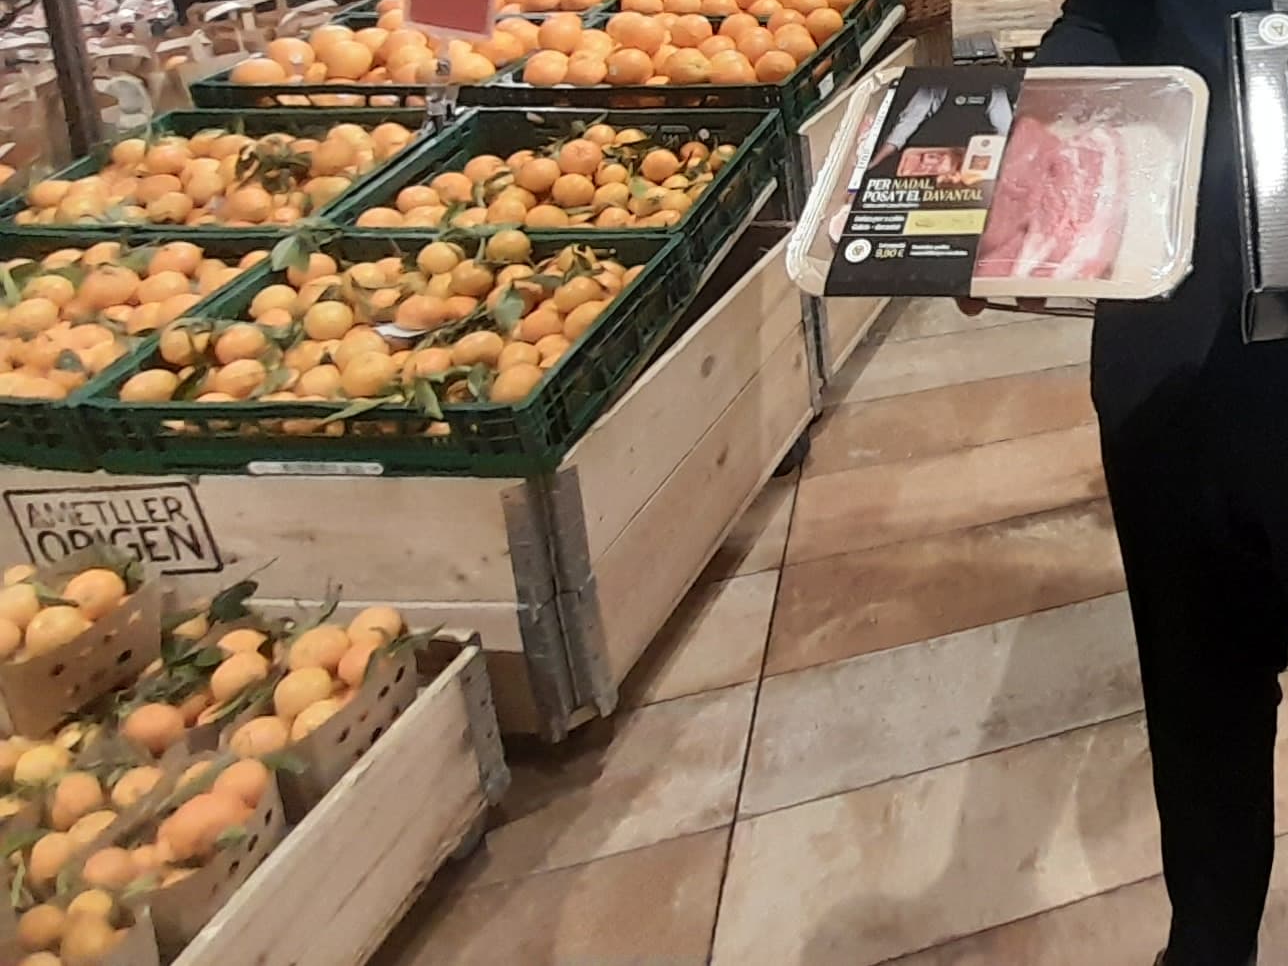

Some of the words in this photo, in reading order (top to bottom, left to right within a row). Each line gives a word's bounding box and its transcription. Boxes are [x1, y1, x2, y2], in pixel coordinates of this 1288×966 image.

[866, 178, 892, 191] PER
[905, 190, 922, 202] EL
[922, 188, 984, 202] DAVANTAL
[25, 495, 190, 529] AMETLLER
